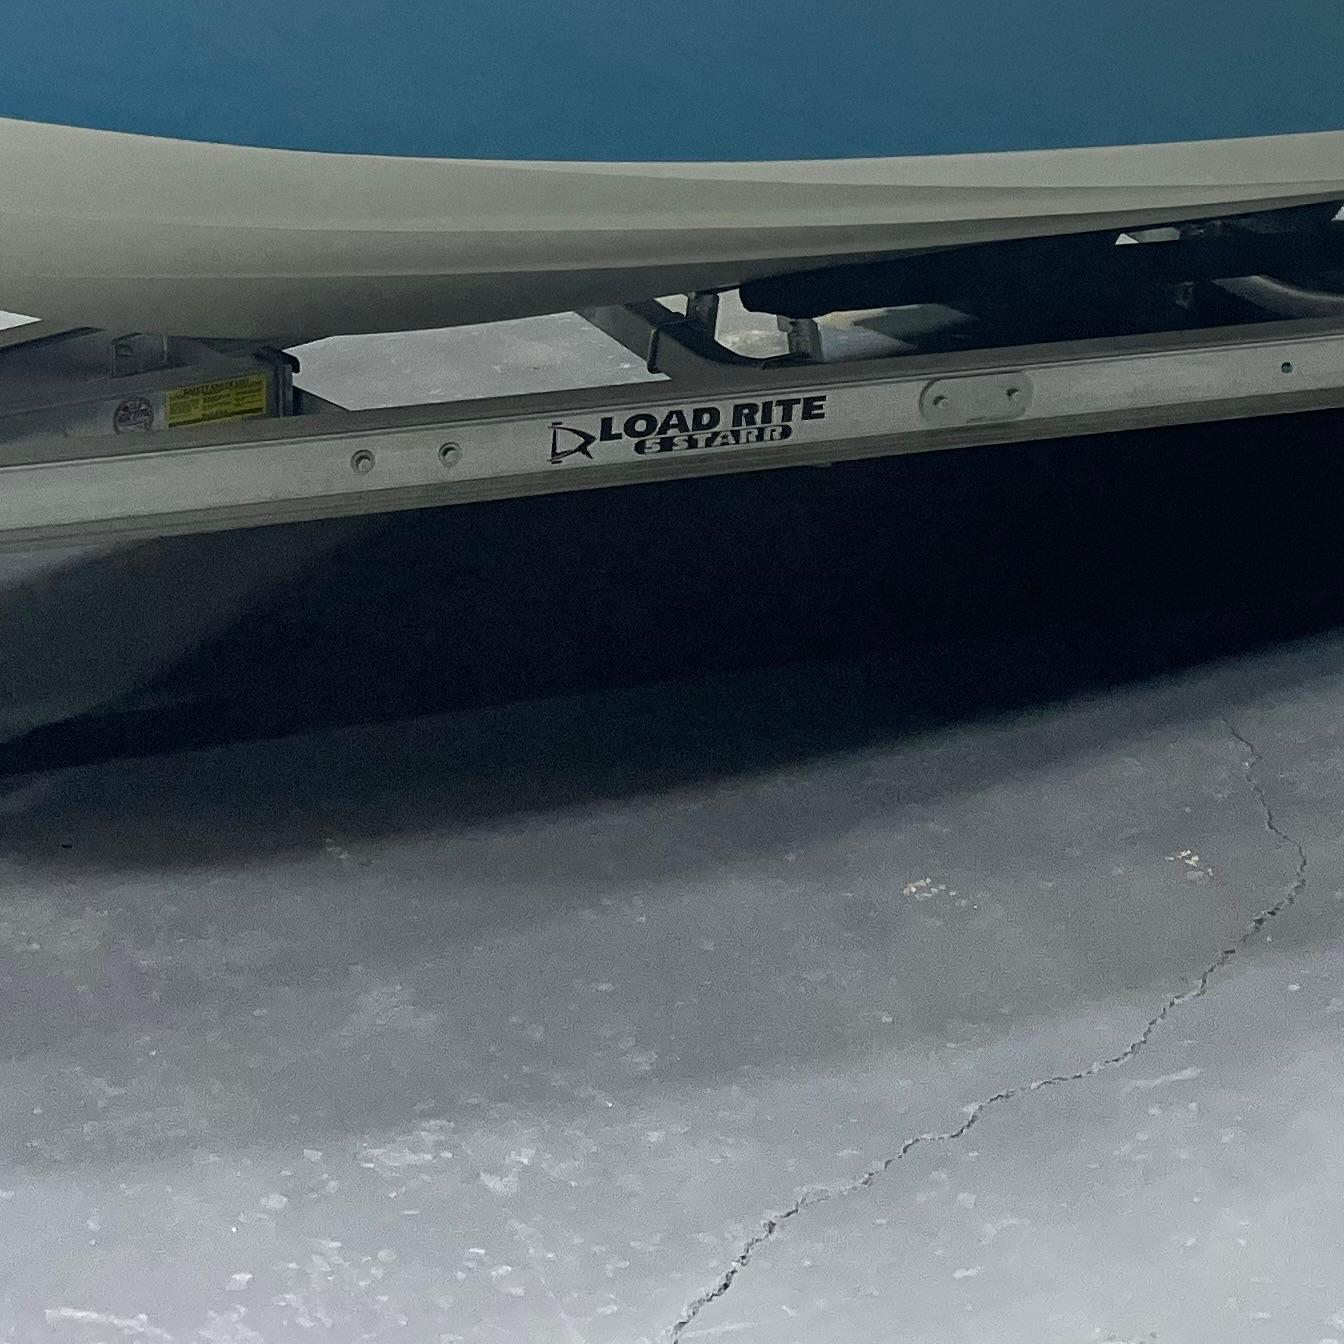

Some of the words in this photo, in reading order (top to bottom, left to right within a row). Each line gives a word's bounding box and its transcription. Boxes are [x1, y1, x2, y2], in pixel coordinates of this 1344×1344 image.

[599, 405, 721, 442] LOAD
[731, 394, 827, 429] RITE
[643, 438, 661, 454] 5
[671, 426, 783, 452] STARR
